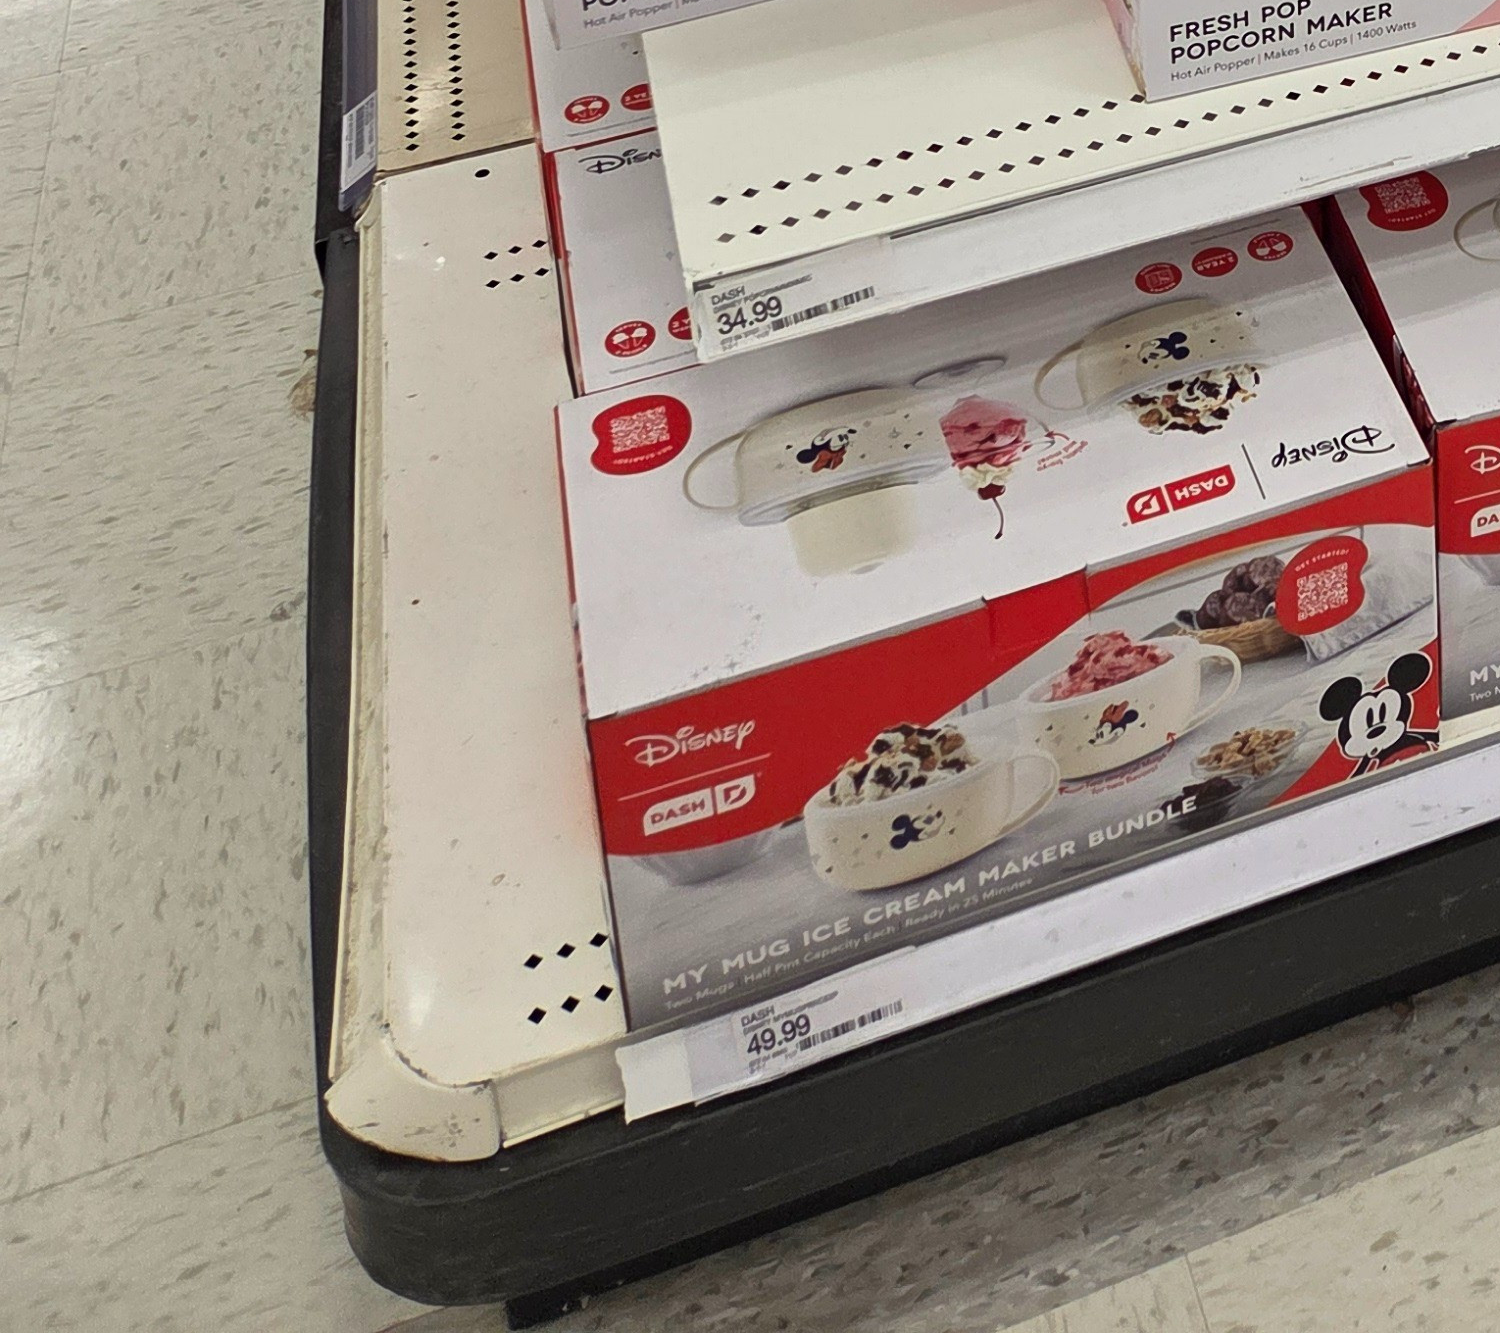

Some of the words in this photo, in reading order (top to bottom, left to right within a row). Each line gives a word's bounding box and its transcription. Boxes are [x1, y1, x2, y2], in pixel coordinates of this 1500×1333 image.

[1170, 10, 1249, 43] FRESH
[1170, 23, 1295, 64] POPCORN
[1307, 1, 1392, 37] MAKER
[1170, 68, 1188, 81] Hot
[1191, 65, 1210, 77] Air
[1213, 56, 1255, 75] Popper
[1264, 46, 1298, 64] Makes
[1303, 41, 1316, 53] 16
[1319, 35, 1348, 53] Cups
[1357, 29, 1384, 43] 1400
[1386, 19, 1416, 35] Watts
[717, 296, 782, 335] 34.99
[623, 718, 755, 768] Disney
[649, 796, 708, 825] DASH
[662, 965, 706, 997] MY
[719, 937, 792, 977] MUG
[801, 917, 851, 948] ICE
[862, 879, 966, 926] CREAM
[978, 840, 1077, 885] MAKER
[1089, 795, 1199, 847] BUNDLE
[741, 1005, 775, 1027] DASH
[747, 1013, 811, 1054] 49.99
